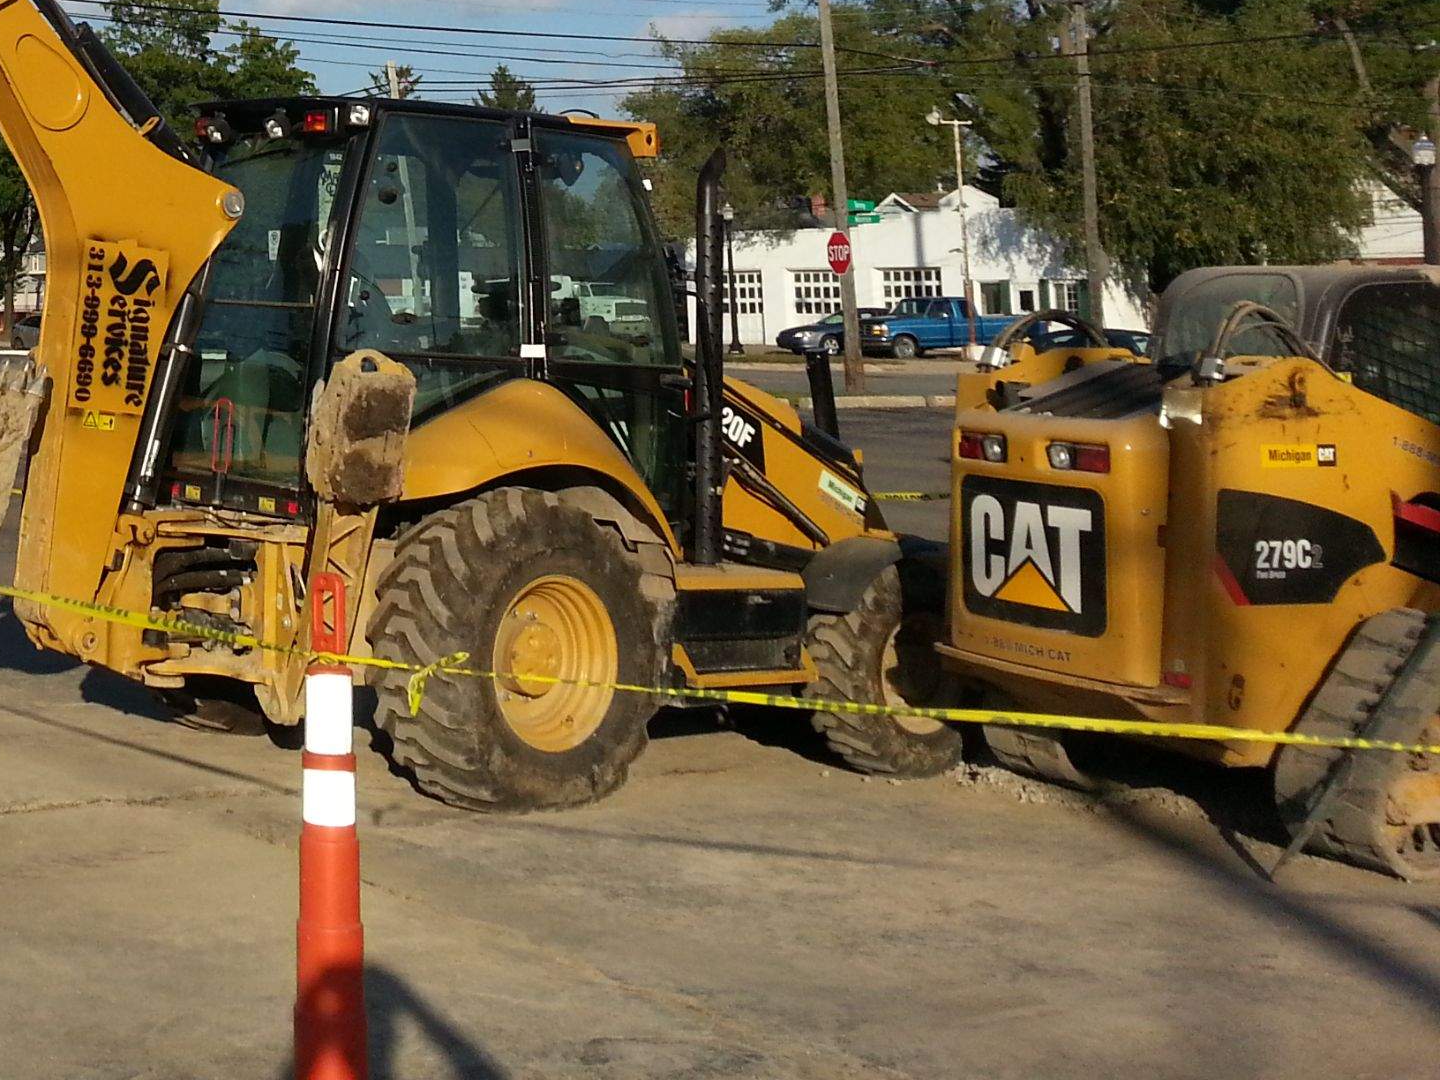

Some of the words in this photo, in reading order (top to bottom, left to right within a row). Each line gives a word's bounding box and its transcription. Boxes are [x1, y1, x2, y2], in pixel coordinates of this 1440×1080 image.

[828, 245, 850, 262] STOP
[74, 246, 106, 402] 313-999-6690
[110, 251, 161, 408] Signature
[1267, 448, 1312, 463] Michigan
[1317, 447, 1335, 462] CAT
[971, 494, 1092, 614] CAT
[1048, 648, 1072, 661] CAT
